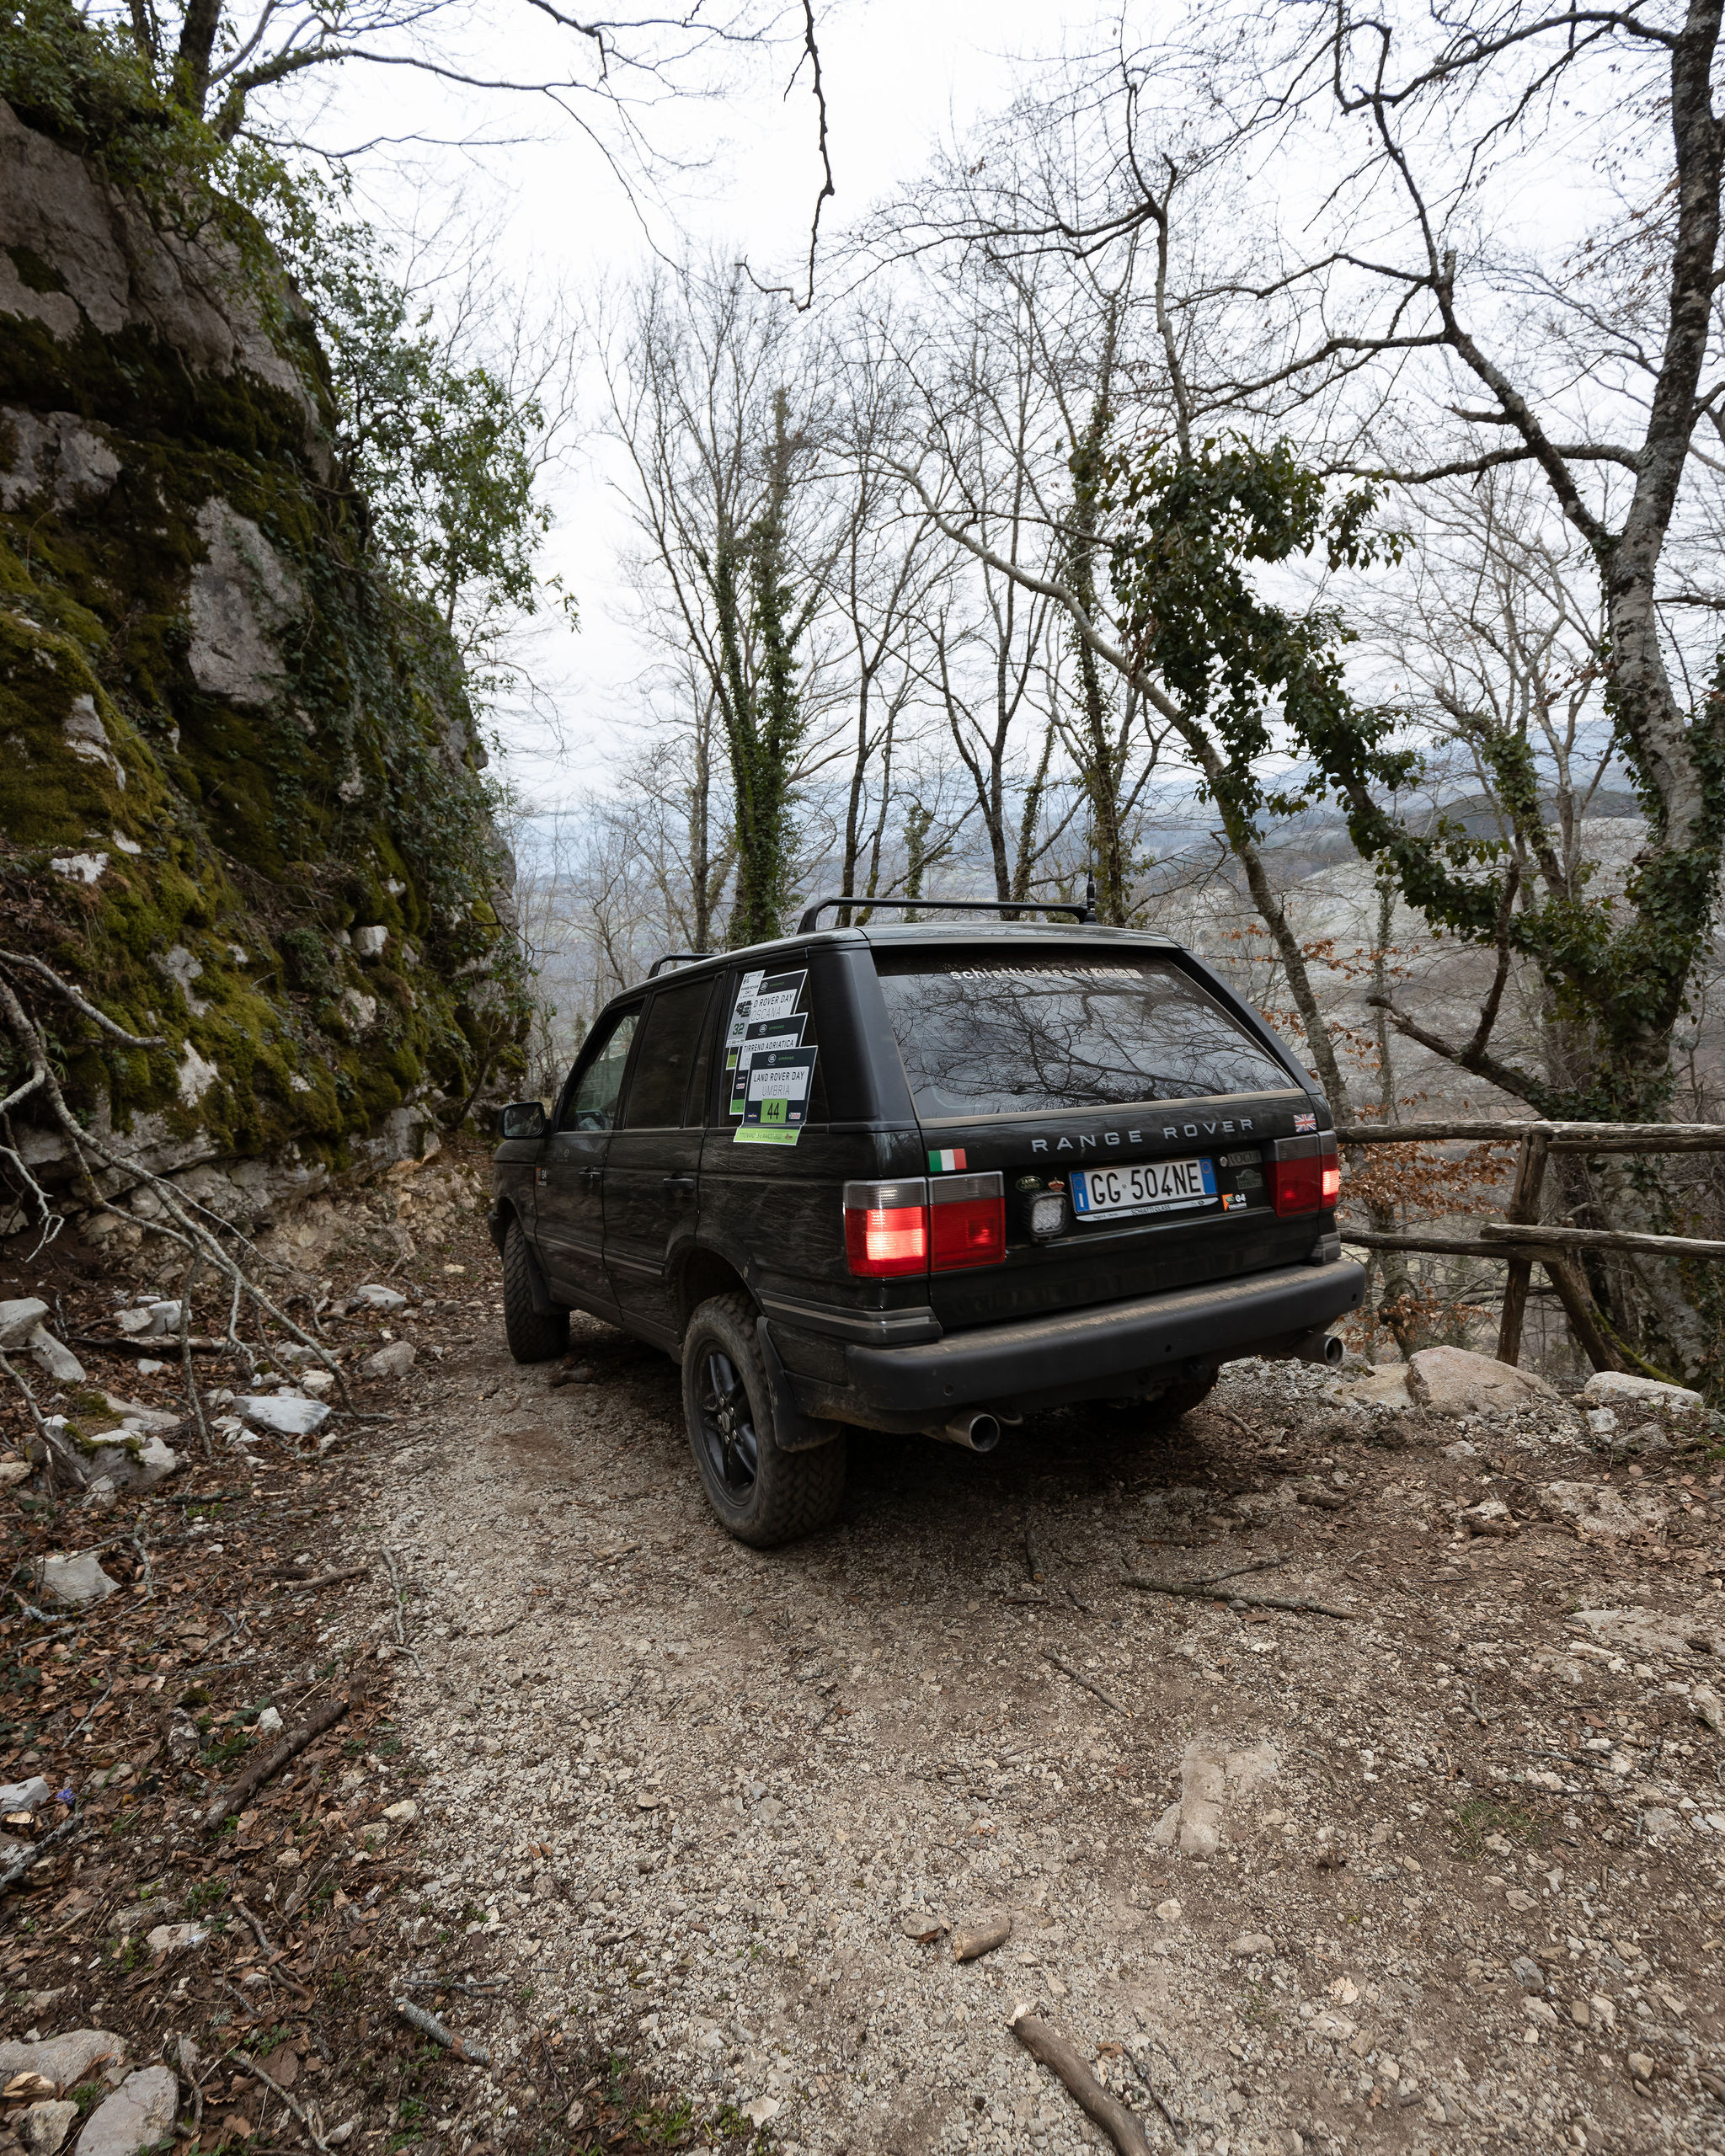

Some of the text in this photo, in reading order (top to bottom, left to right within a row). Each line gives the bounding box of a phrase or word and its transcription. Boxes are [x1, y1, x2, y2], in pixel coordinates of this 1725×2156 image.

[950, 968, 1092, 980] schiatticlassit
[759, 995, 779, 1007] ROVER
[780, 993, 794, 1003] DAY
[751, 1006, 781, 1022] OSCANA
[732, 1022, 745, 1036] 32
[743, 1039, 793, 1054] TIRRENO ADRIATICA
[753, 1070, 805, 1082] LAND ROVER DAY
[761, 1084, 790, 1097] UMBRIA
[767, 1102, 780, 1120] 44
[1031, 1118, 1254, 1153] RANGE ROVER
[1235, 1193, 1247, 1203] G4
